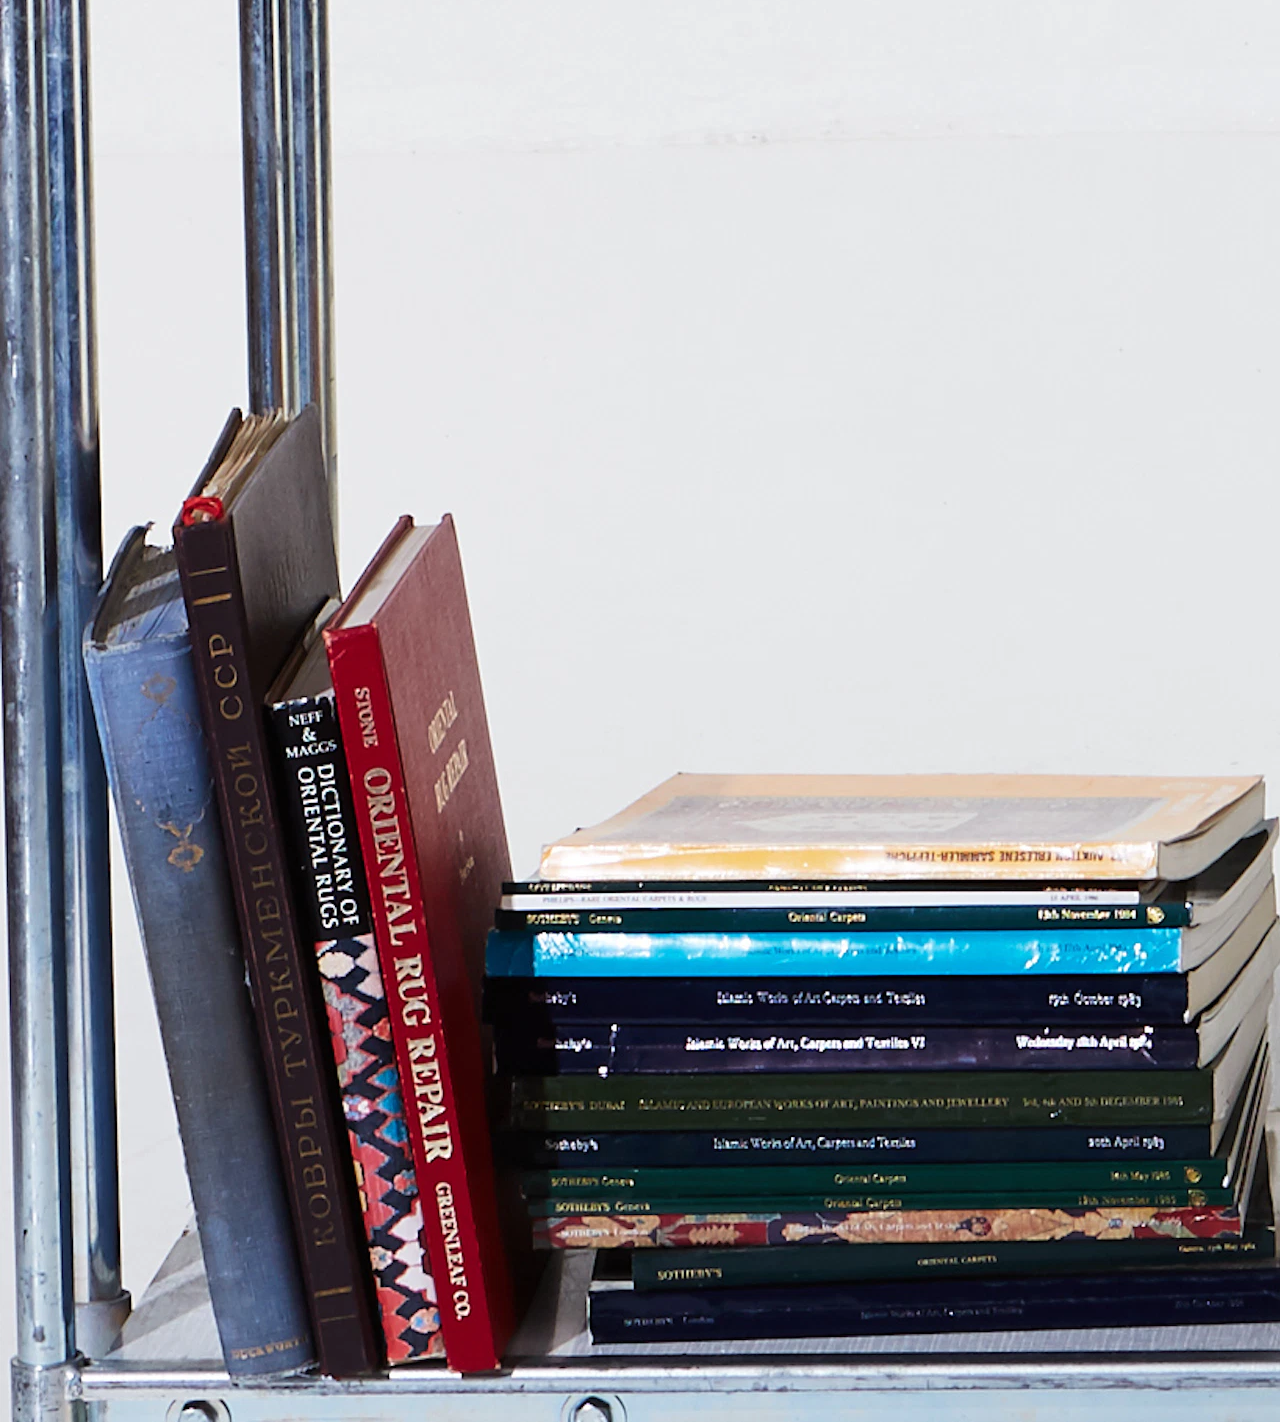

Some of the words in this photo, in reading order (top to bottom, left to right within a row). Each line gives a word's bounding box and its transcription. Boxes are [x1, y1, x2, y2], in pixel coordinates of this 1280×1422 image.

[287, 714, 327, 729] NEFF
[301, 728, 316, 742] &
[352, 687, 379, 748] STONE
[285, 741, 337, 758] MAGGS
[297, 766, 331, 869] ORIENTAL
[314, 874, 339, 929] RUGS
[316, 763, 354, 890] DICTIONARY
[339, 895, 361, 926] OF
[363, 766, 417, 947] ORIENTAL
[788, 912, 825, 923] Oriental
[829, 912, 866, 923] Carpets
[1062, 908, 1112, 920] November
[394, 955, 431, 1029] RUG
[405, 1035, 453, 1163] REPAIR
[713, 1137, 746, 1150] Islamic
[750, 1137, 783, 1150] Works
[817, 1138, 854, 1152] Carpets
[855, 1138, 875, 1150] and
[433, 1181, 466, 1286] GREENLEAF
[452, 1289, 471, 1321] CO.
